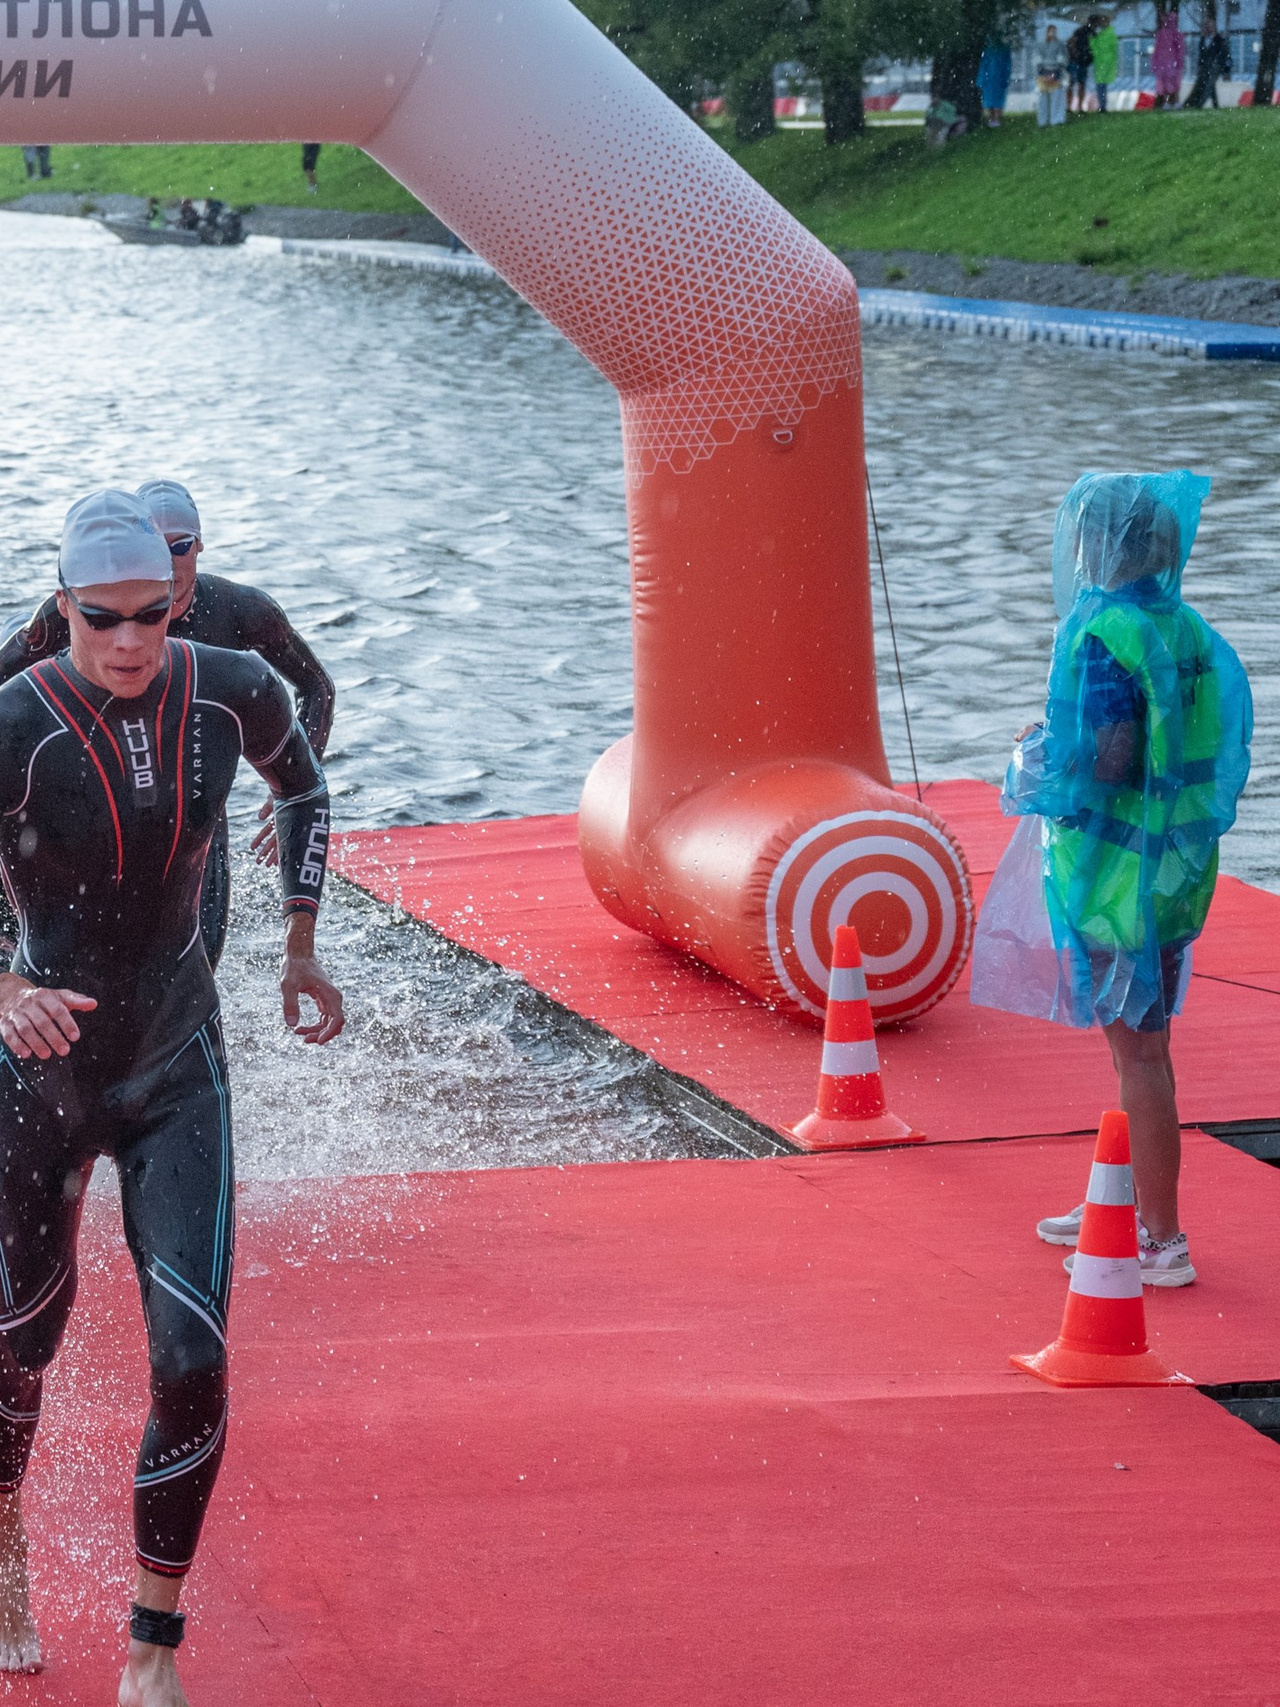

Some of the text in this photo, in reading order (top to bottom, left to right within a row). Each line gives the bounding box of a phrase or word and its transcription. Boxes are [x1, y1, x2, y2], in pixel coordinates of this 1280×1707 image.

[122, 718, 154, 789] HUUB
[192, 713, 202, 799] VARMAN
[299, 808, 329, 887] HUUB
[145, 1427, 213, 1468] VARMAN
